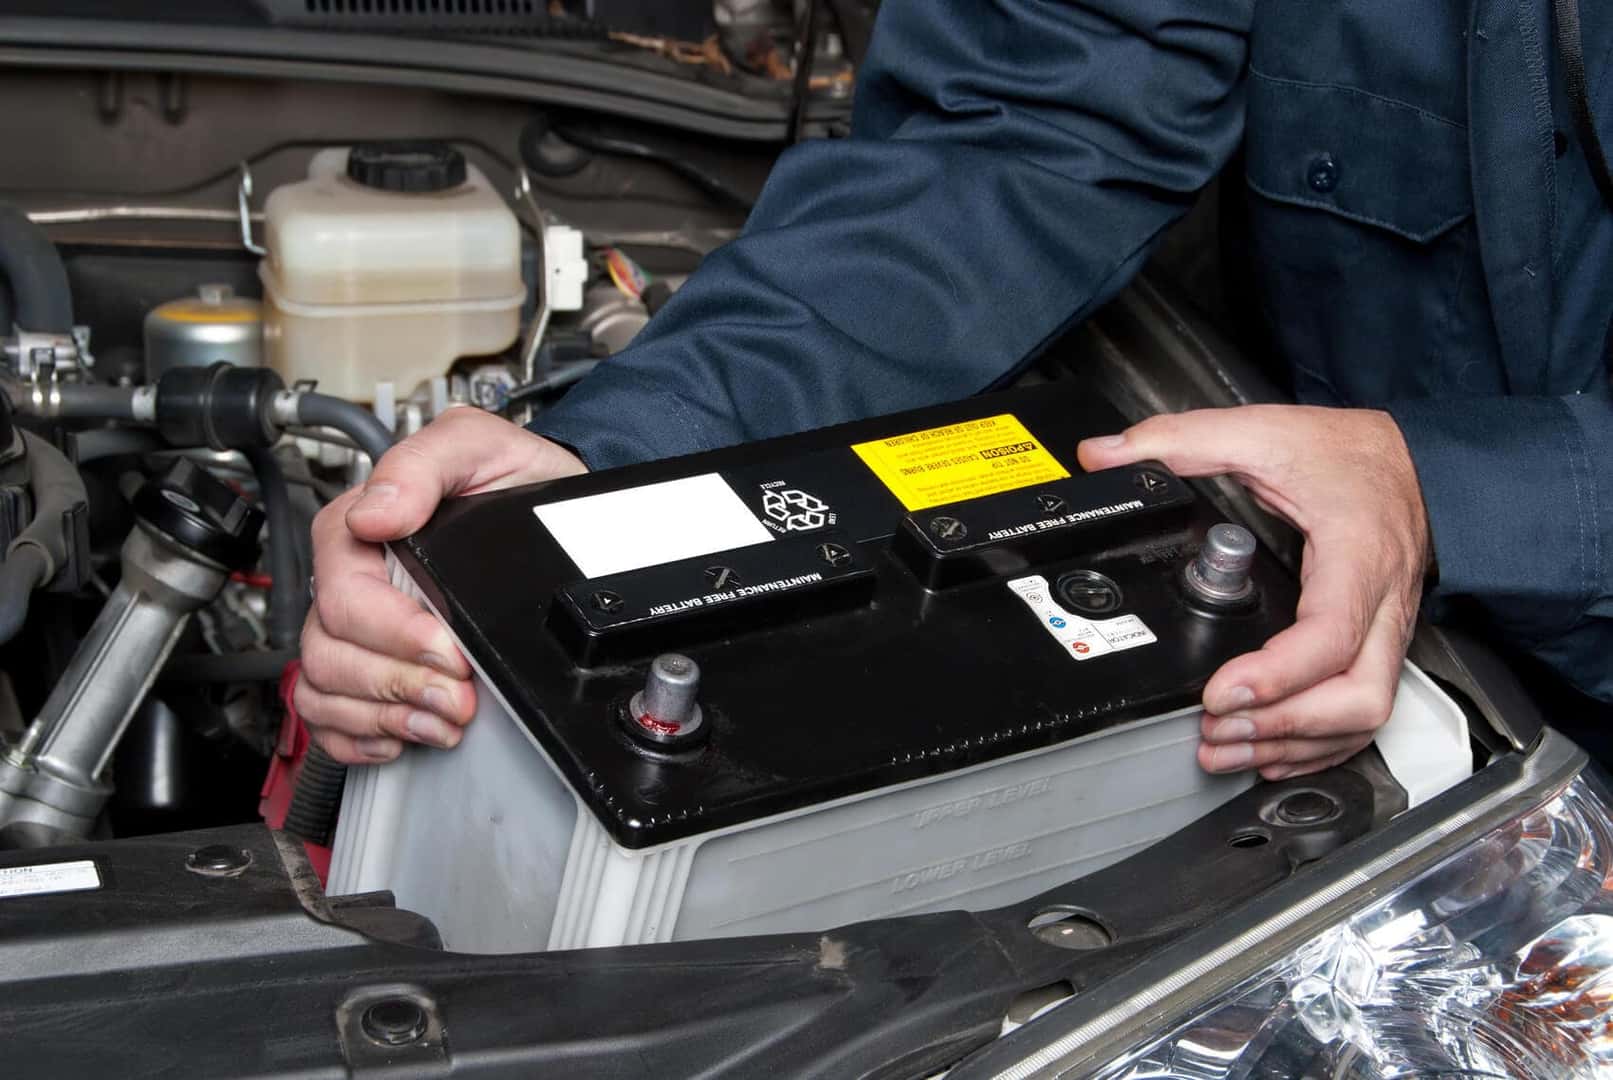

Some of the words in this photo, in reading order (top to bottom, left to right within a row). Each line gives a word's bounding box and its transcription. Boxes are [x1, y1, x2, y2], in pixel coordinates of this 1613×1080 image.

[982, 443, 1026, 459] POISON
[760, 480, 786, 490] RECYCLE
[1066, 500, 1144, 523] MAINTENANCE
[761, 519, 787, 534] RETURN
[1036, 515, 1067, 530] FREE
[988, 524, 1037, 541] BATTERY
[736, 572, 823, 597] MAINTENANCE
[703, 589, 736, 604] FREE
[649, 597, 703, 616] BATTERY
[1108, 630, 1147, 644] INDICATOR
[913, 798, 982, 830] UPPER
[986, 776, 1053, 810] LEVEL
[891, 859, 969, 895] LOWER
[971, 842, 1033, 872] LEVEL
